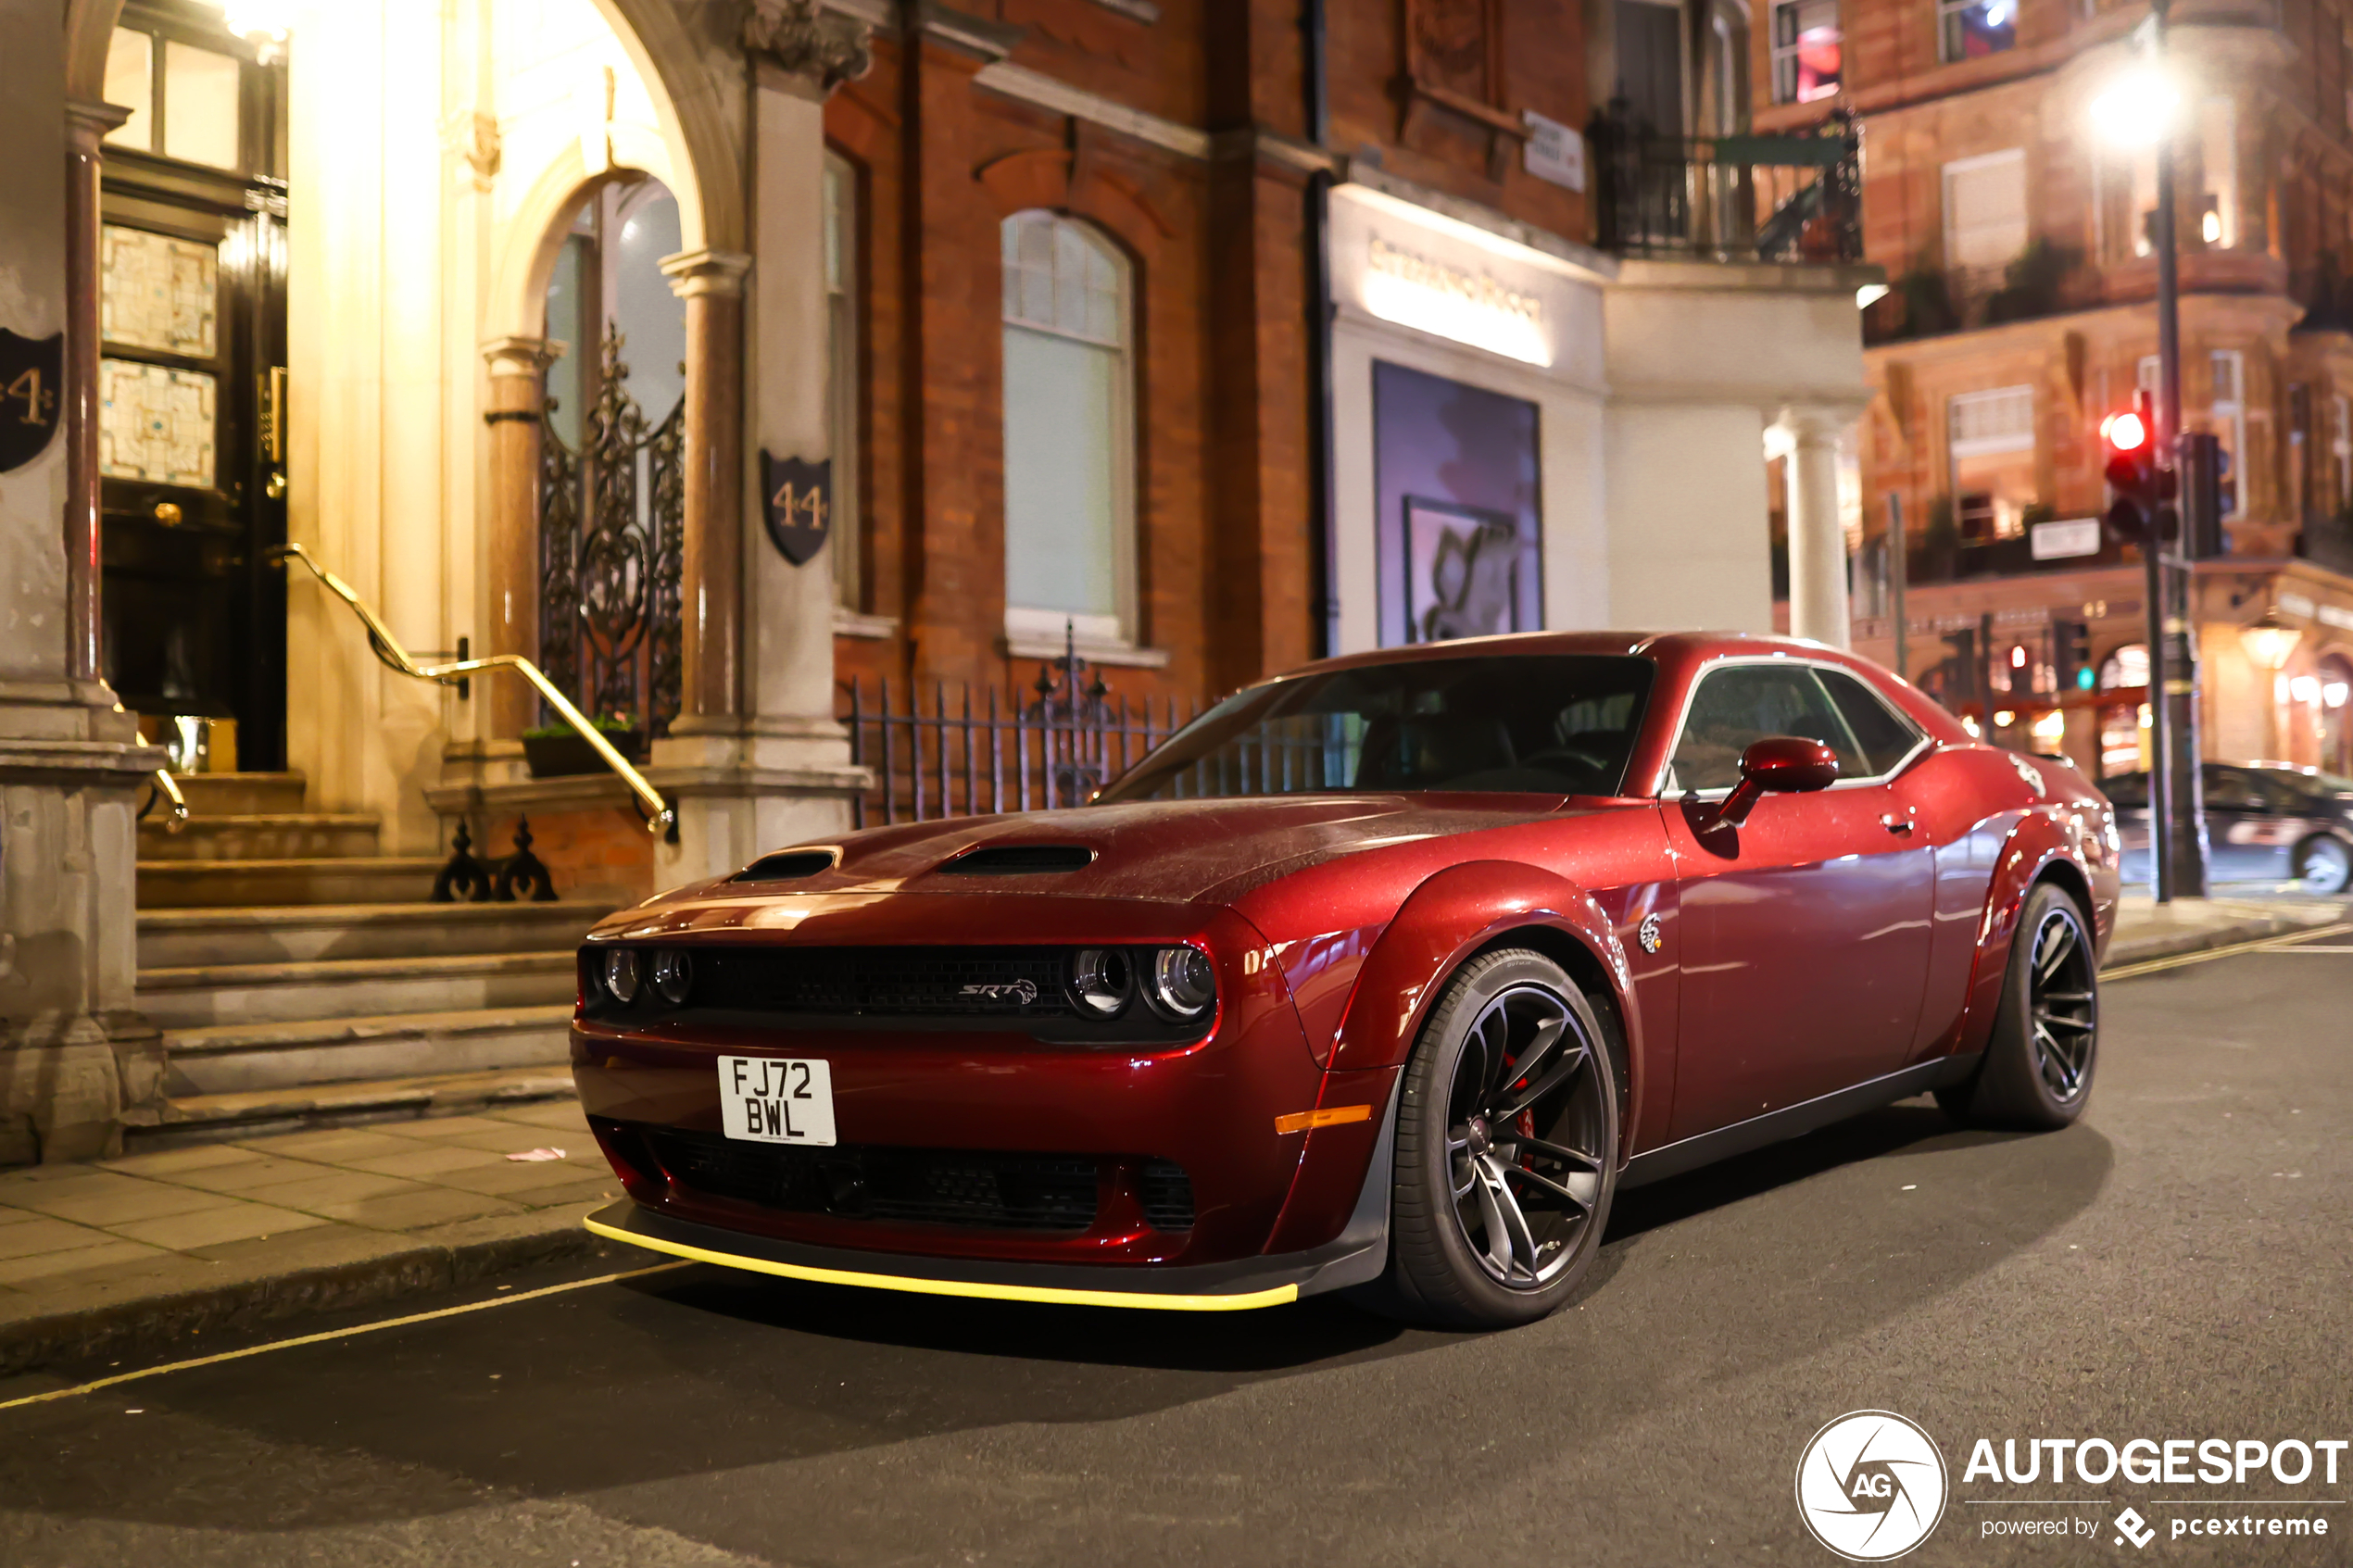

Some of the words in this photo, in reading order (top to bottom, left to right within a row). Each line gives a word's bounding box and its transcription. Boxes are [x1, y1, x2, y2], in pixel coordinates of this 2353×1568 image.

[773, 481, 828, 530] 44
[959, 985, 1020, 998] SRT
[733, 1059, 812, 1099] FJ72
[745, 1098, 804, 1137] BWL
